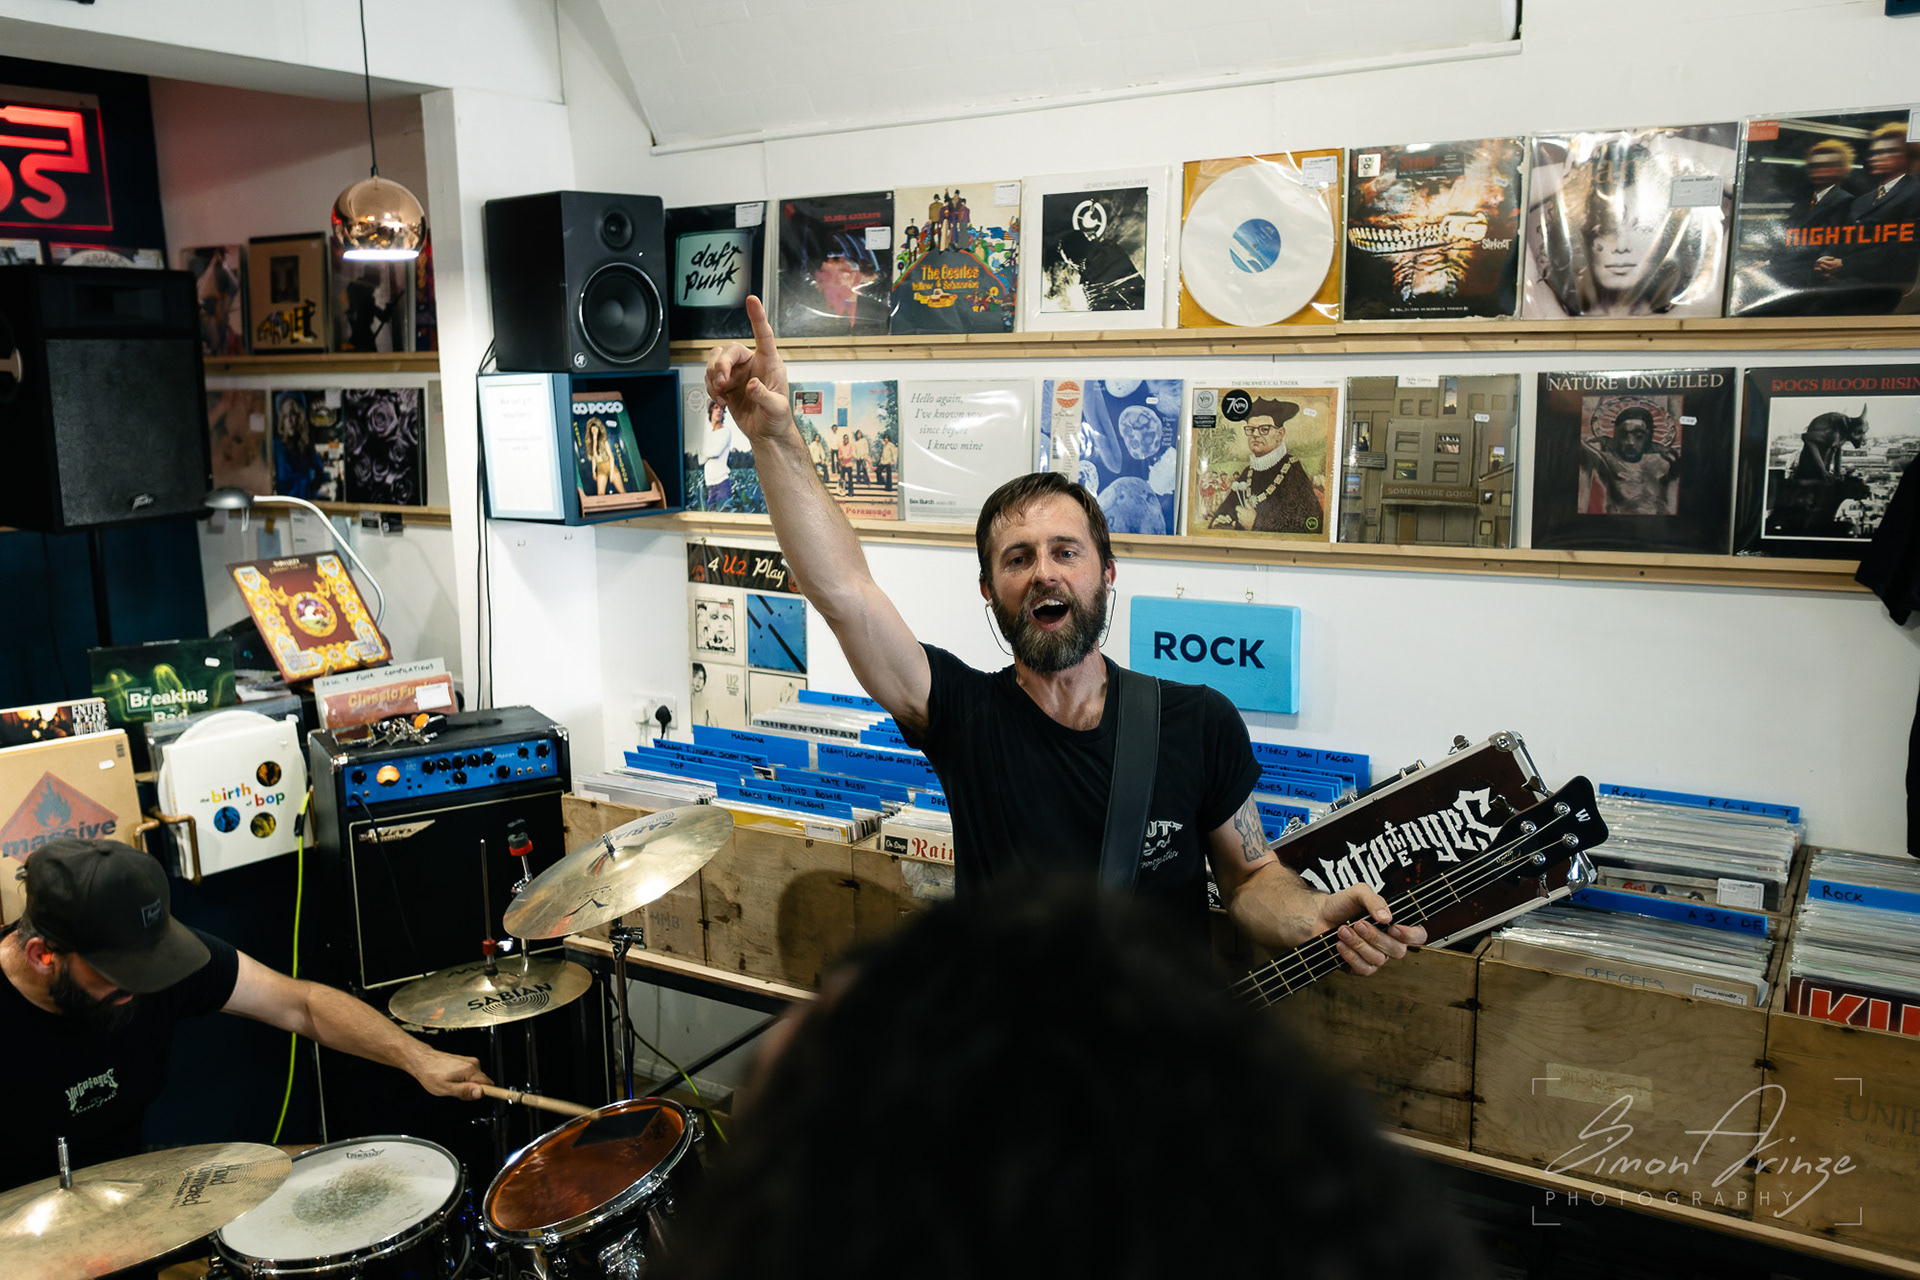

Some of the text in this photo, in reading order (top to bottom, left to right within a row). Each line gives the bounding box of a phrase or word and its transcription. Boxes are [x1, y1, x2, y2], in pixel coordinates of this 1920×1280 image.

[1785, 223, 1915, 246] NIGHTLIFE
[691, 241, 743, 271] daft
[683, 260, 741, 300] punk
[922, 265, 940, 280] The
[1549, 373, 1724, 391] NATURE UNVEILED
[1771, 378, 1818, 392] DOGS
[1821, 378, 1878, 391] BLOOD
[910, 393, 963, 406] Hello again,
[915, 408, 931, 419] I've
[934, 408, 965, 419] known
[919, 424, 940, 434] since
[933, 439, 958, 450] knew
[960, 440, 983, 451] mine
[1388, 487, 1473, 498] SOMEWHERE GOOD
[708, 554, 785, 588] 4 U2 Play
[1153, 630, 1266, 669] ROCK
[726, 673, 739, 687] U2
[130, 688, 208, 708] Breaking
[72, 702, 107, 718] ENTER
[153, 708, 189, 723] Bad
[761, 719, 808, 733] DURAN
[811, 727, 859, 740] DURAN
[731, 732, 765, 745] MADONNA
[669, 760, 685, 771] POP
[1325, 752, 1354, 764] FAGEN
[781, 783, 807, 797] DAVID
[820, 776, 866, 791] KATE BUSH
[211, 783, 252, 804] birth
[254, 792, 285, 807] bop
[1294, 788, 1317, 799] SOLO
[1575, 808, 1591, 823] W
[467, 982, 553, 1011] SABIAN
